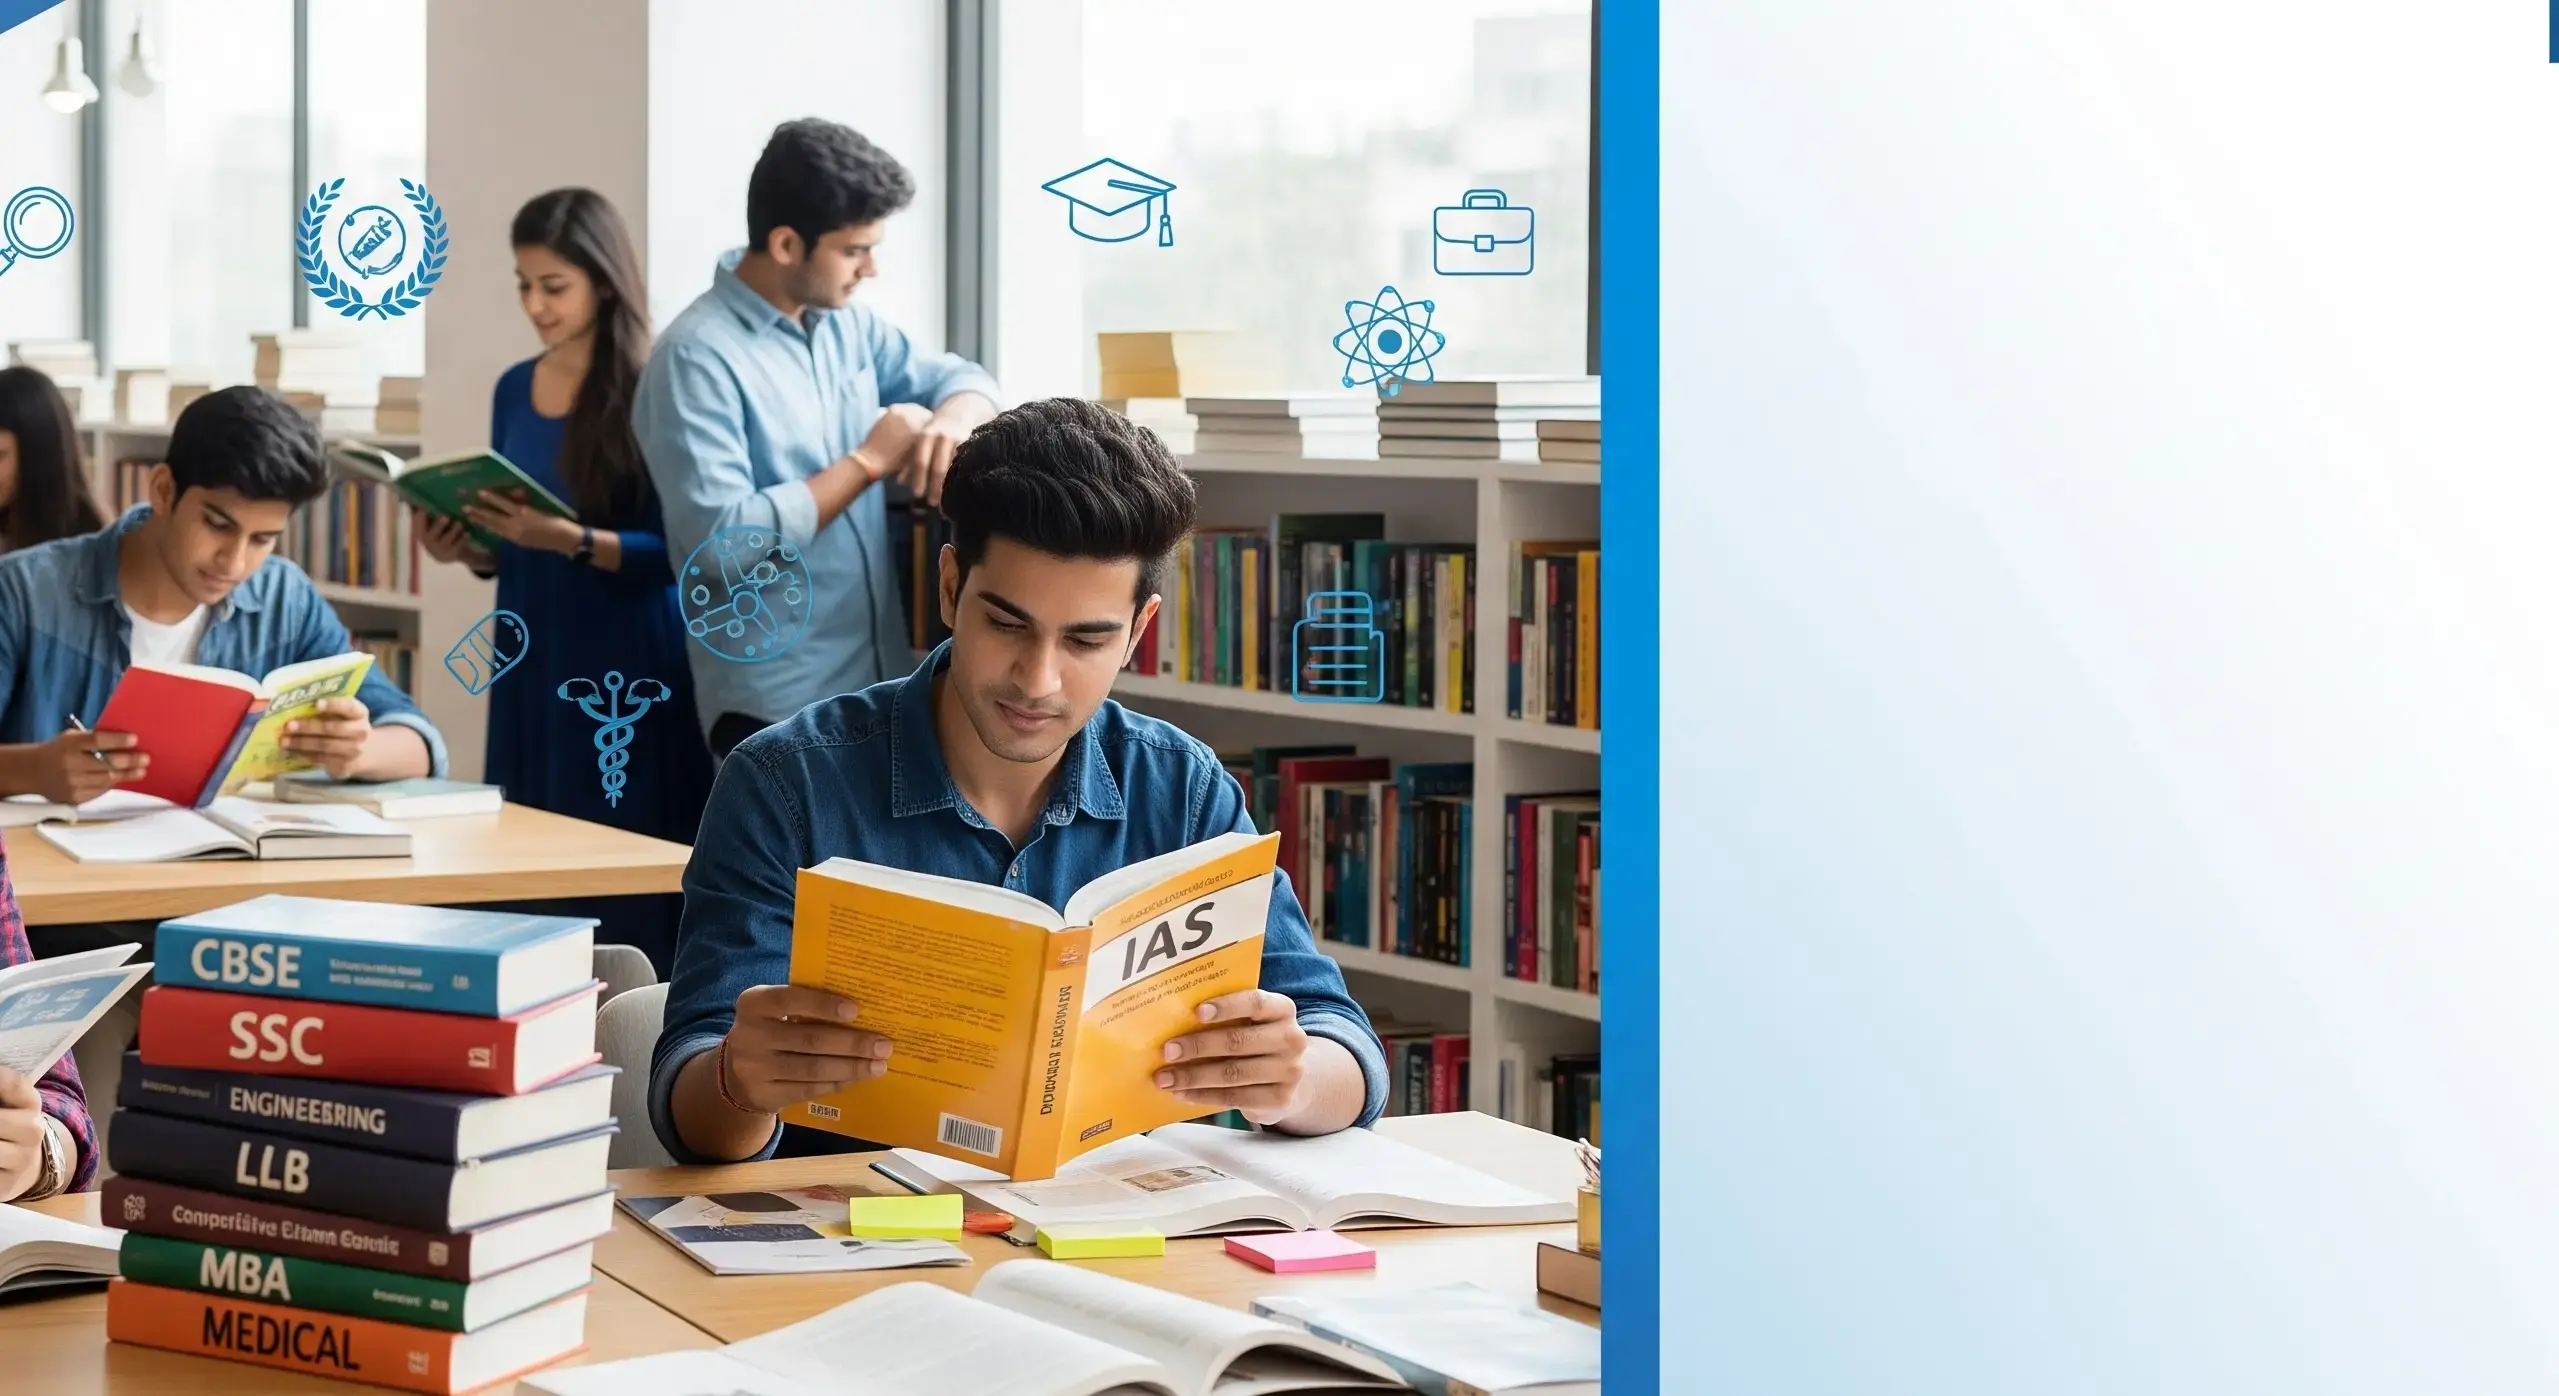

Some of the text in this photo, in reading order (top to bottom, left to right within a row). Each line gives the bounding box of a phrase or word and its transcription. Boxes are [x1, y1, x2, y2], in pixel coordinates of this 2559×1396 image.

[191, 938, 301, 989] CBSE
[1122, 902, 1215, 981] IAS
[229, 1011, 325, 1066] SSC
[236, 1141, 310, 1194] LLB
[200, 1248, 291, 1300] MBA
[202, 1306, 361, 1371] MEDICAL
